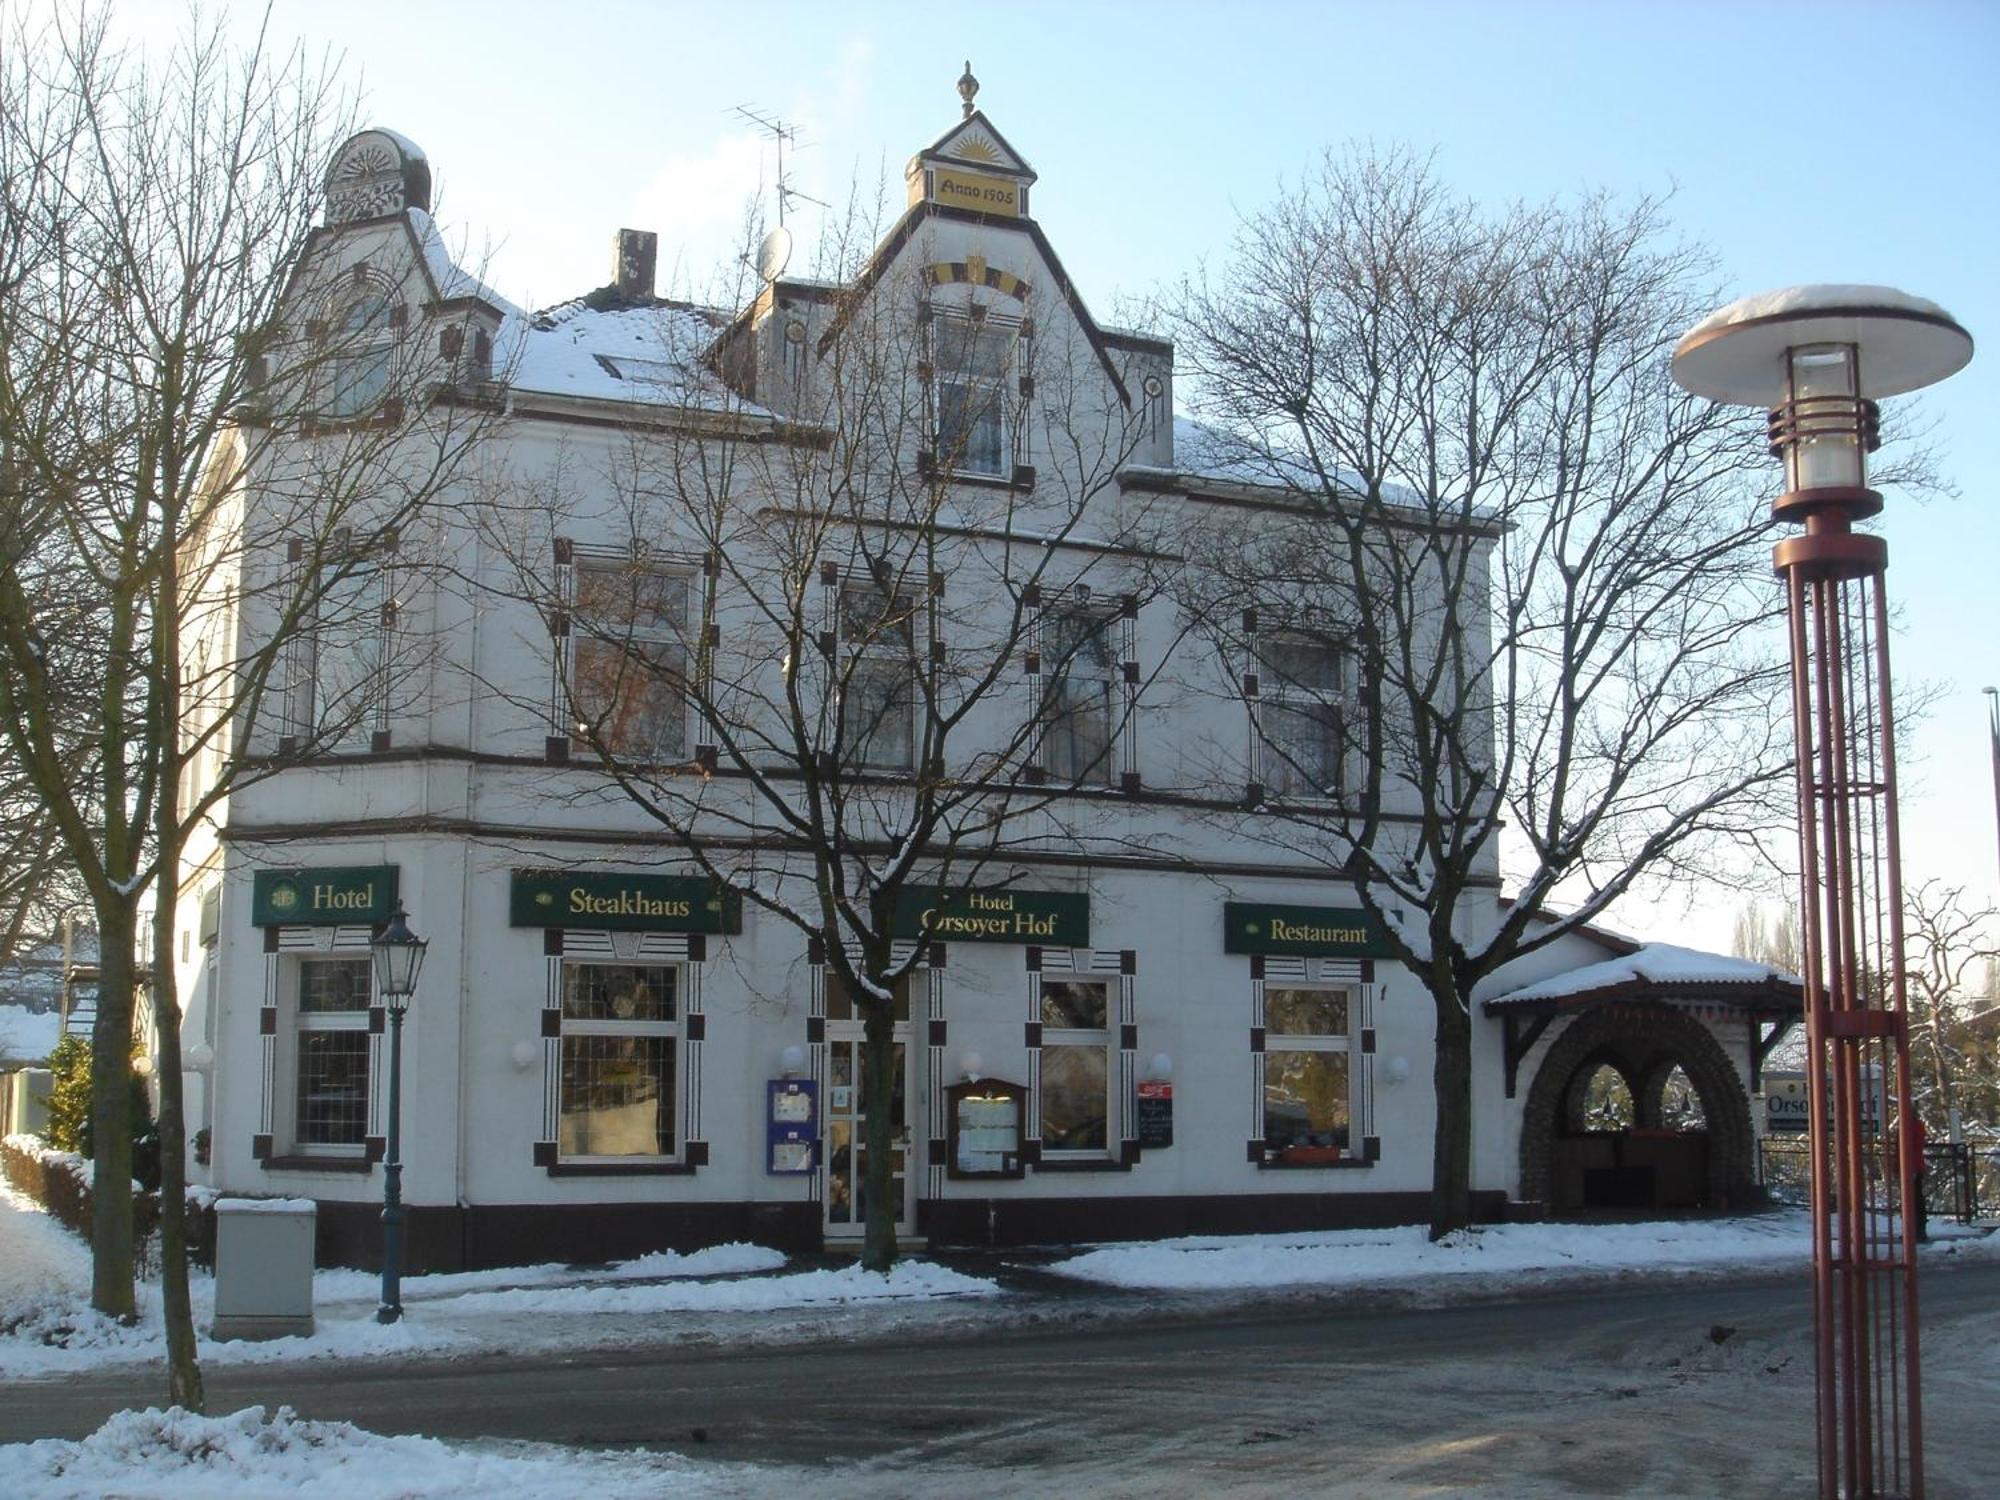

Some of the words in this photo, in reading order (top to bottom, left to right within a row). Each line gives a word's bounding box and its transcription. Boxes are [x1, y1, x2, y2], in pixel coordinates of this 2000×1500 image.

[941, 179, 980, 198] Anno
[984, 188, 1014, 204] 1905
[312, 883, 373, 909] Hotel
[569, 888, 691, 917] Steakhaus
[970, 894, 1013, 911] Hotel
[921, 908, 1010, 937] Orsoyer
[1014, 913, 1058, 936] Hof
[1271, 919, 1368, 944] Restaurant
